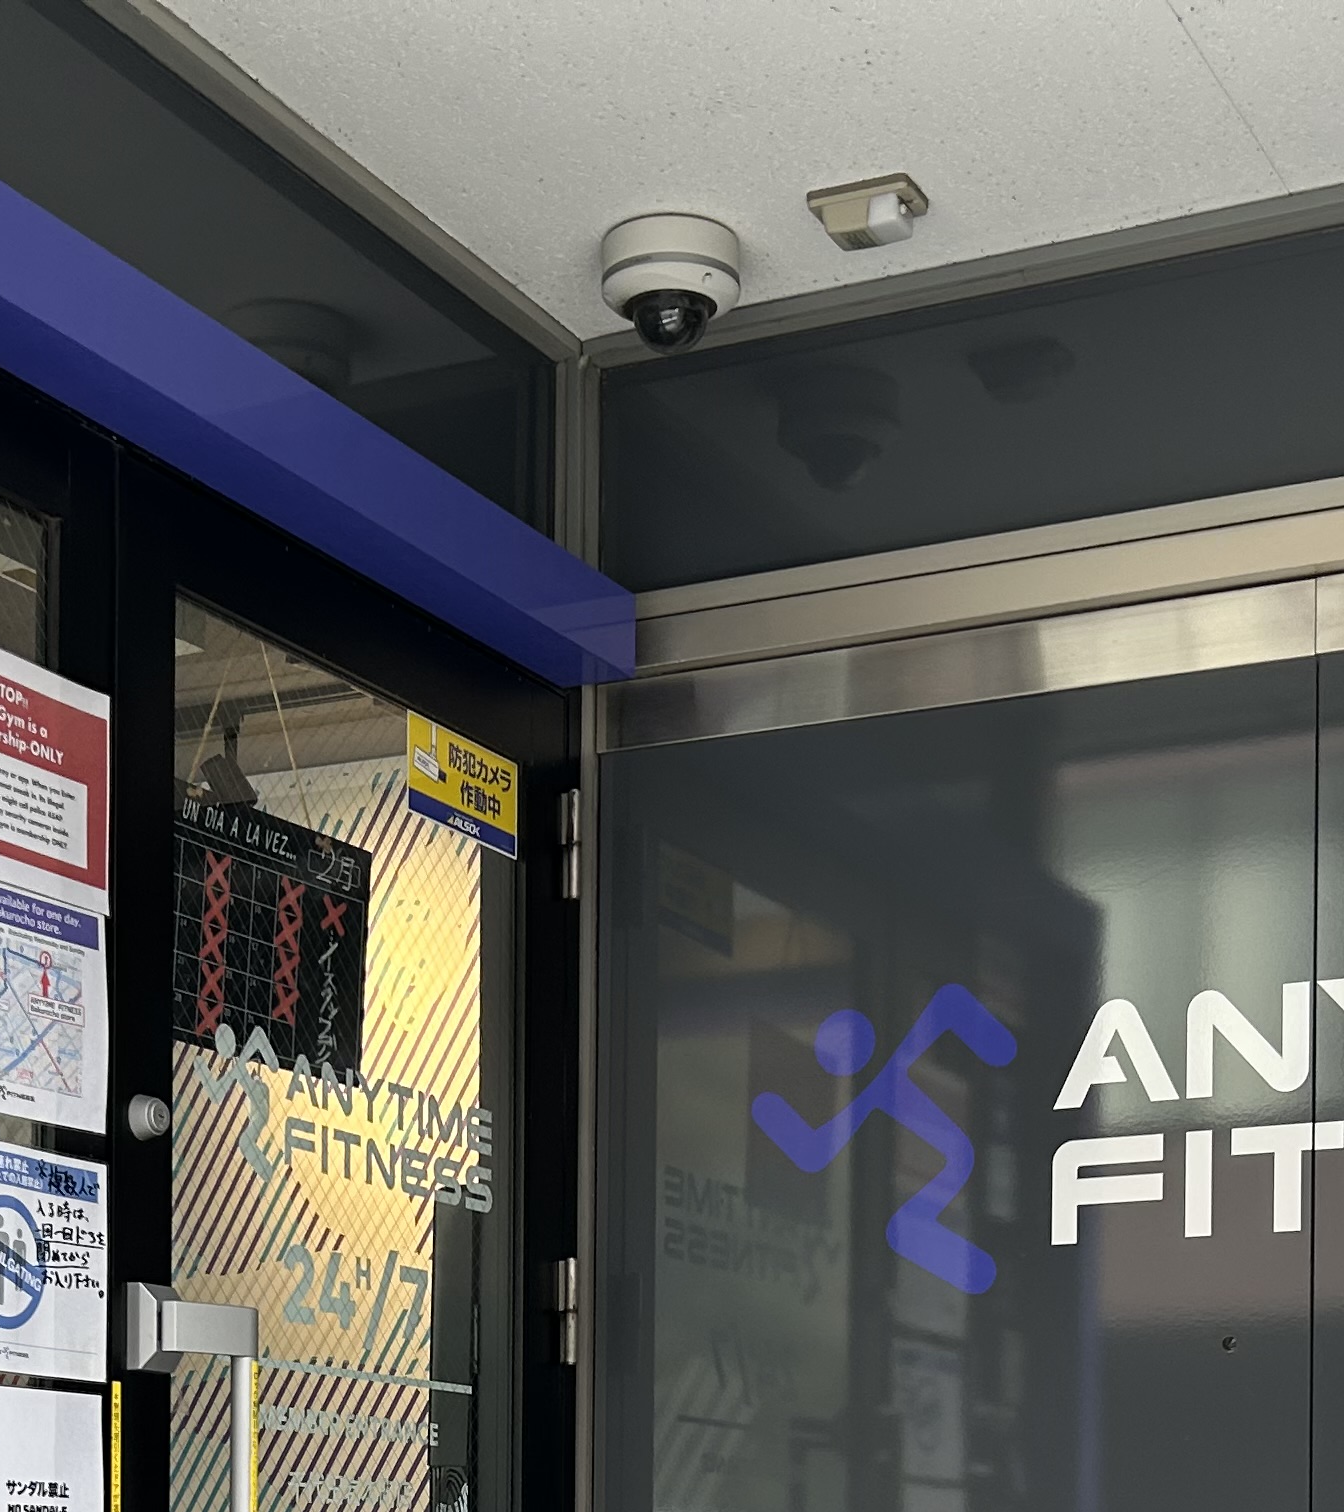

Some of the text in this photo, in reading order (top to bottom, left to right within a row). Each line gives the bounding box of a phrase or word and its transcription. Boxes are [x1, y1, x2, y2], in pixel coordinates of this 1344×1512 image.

[28, 716, 37, 734] is
[39, 727, 48, 739] a
[448, 741, 512, 793] 防犯カメラ
[460, 779, 501, 821] 作動中
[183, 798, 199, 823] UN
[229, 822, 239, 839] A
[246, 826, 260, 845] LA
[31, 902, 45, 916] for
[36, 919, 62, 936] store.
[285, 1054, 494, 1157] ANYTIME
[284, 1116, 494, 1215] FITNESS
[6, 1479, 70, 1498] サンダル禁止
